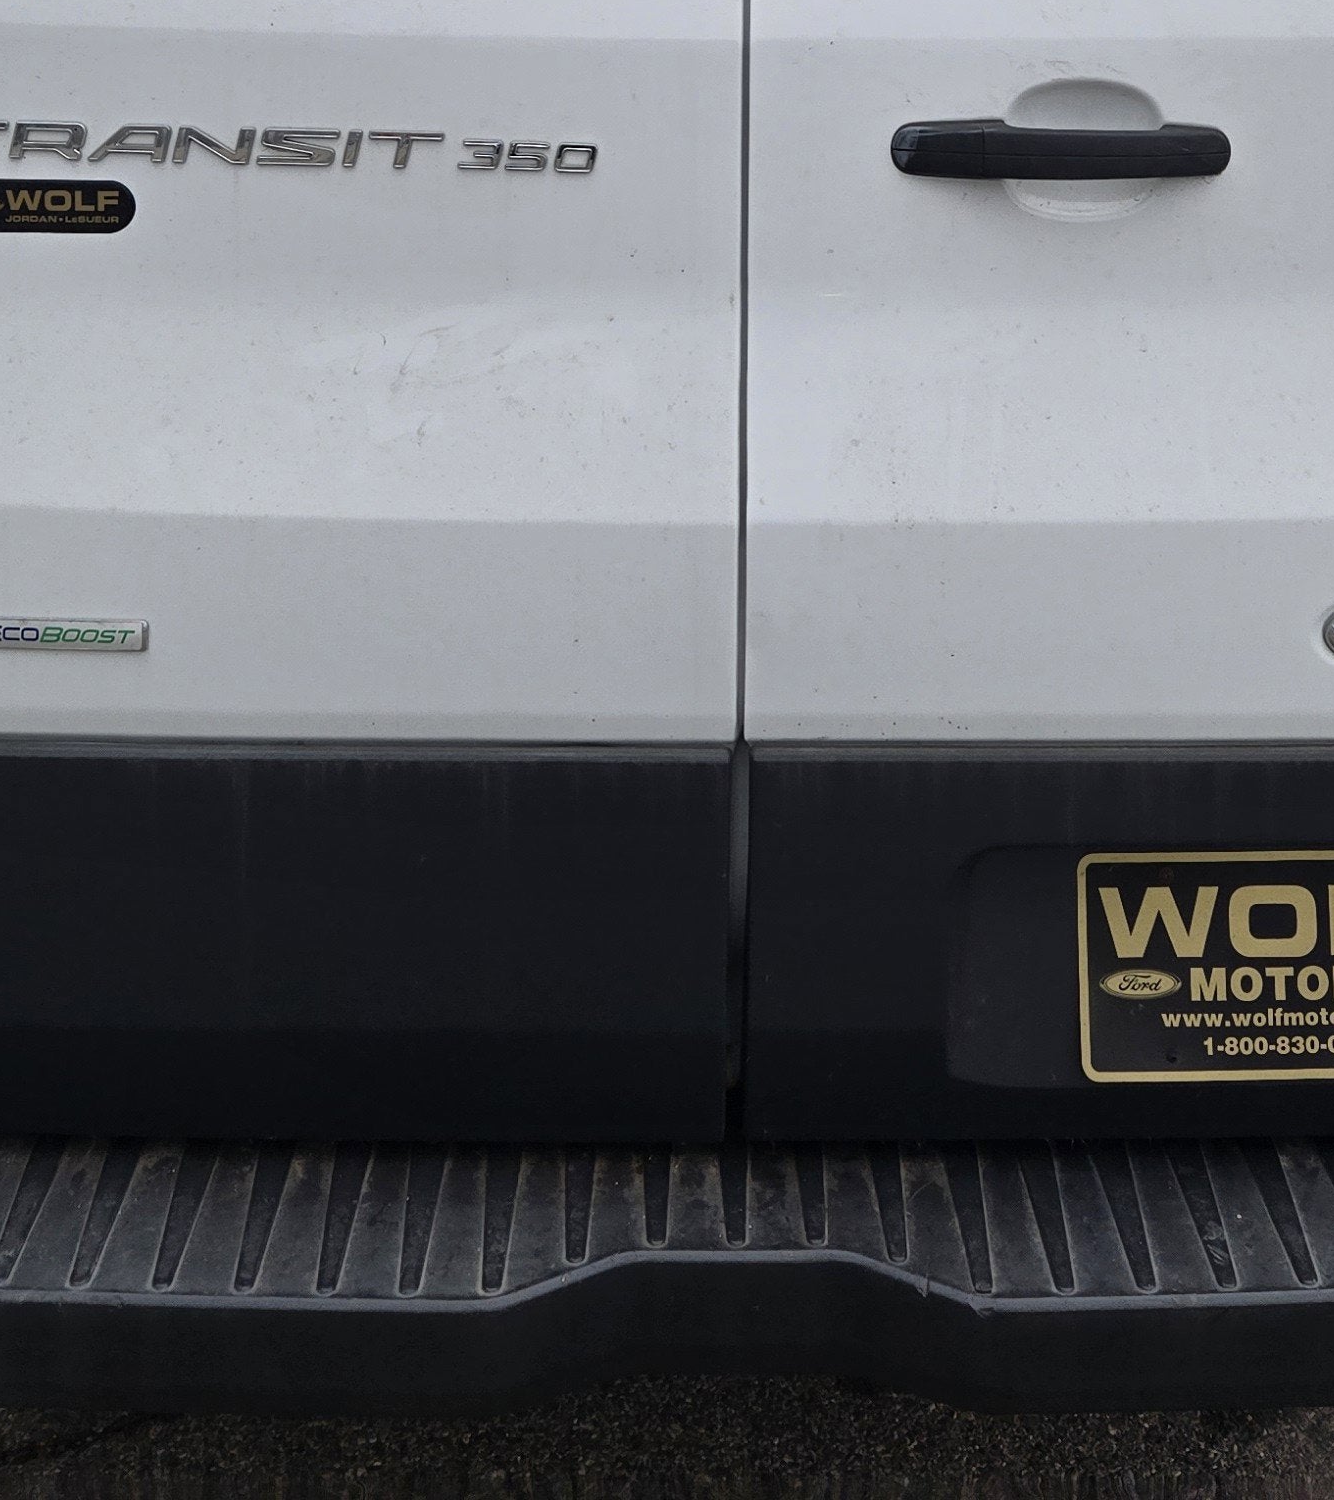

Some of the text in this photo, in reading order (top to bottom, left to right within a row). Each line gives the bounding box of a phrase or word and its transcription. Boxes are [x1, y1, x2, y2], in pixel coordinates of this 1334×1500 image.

[457, 138, 599, 174] 350
[5, 189, 120, 212] WOLF
[1118, 974, 1163, 992] Ford
